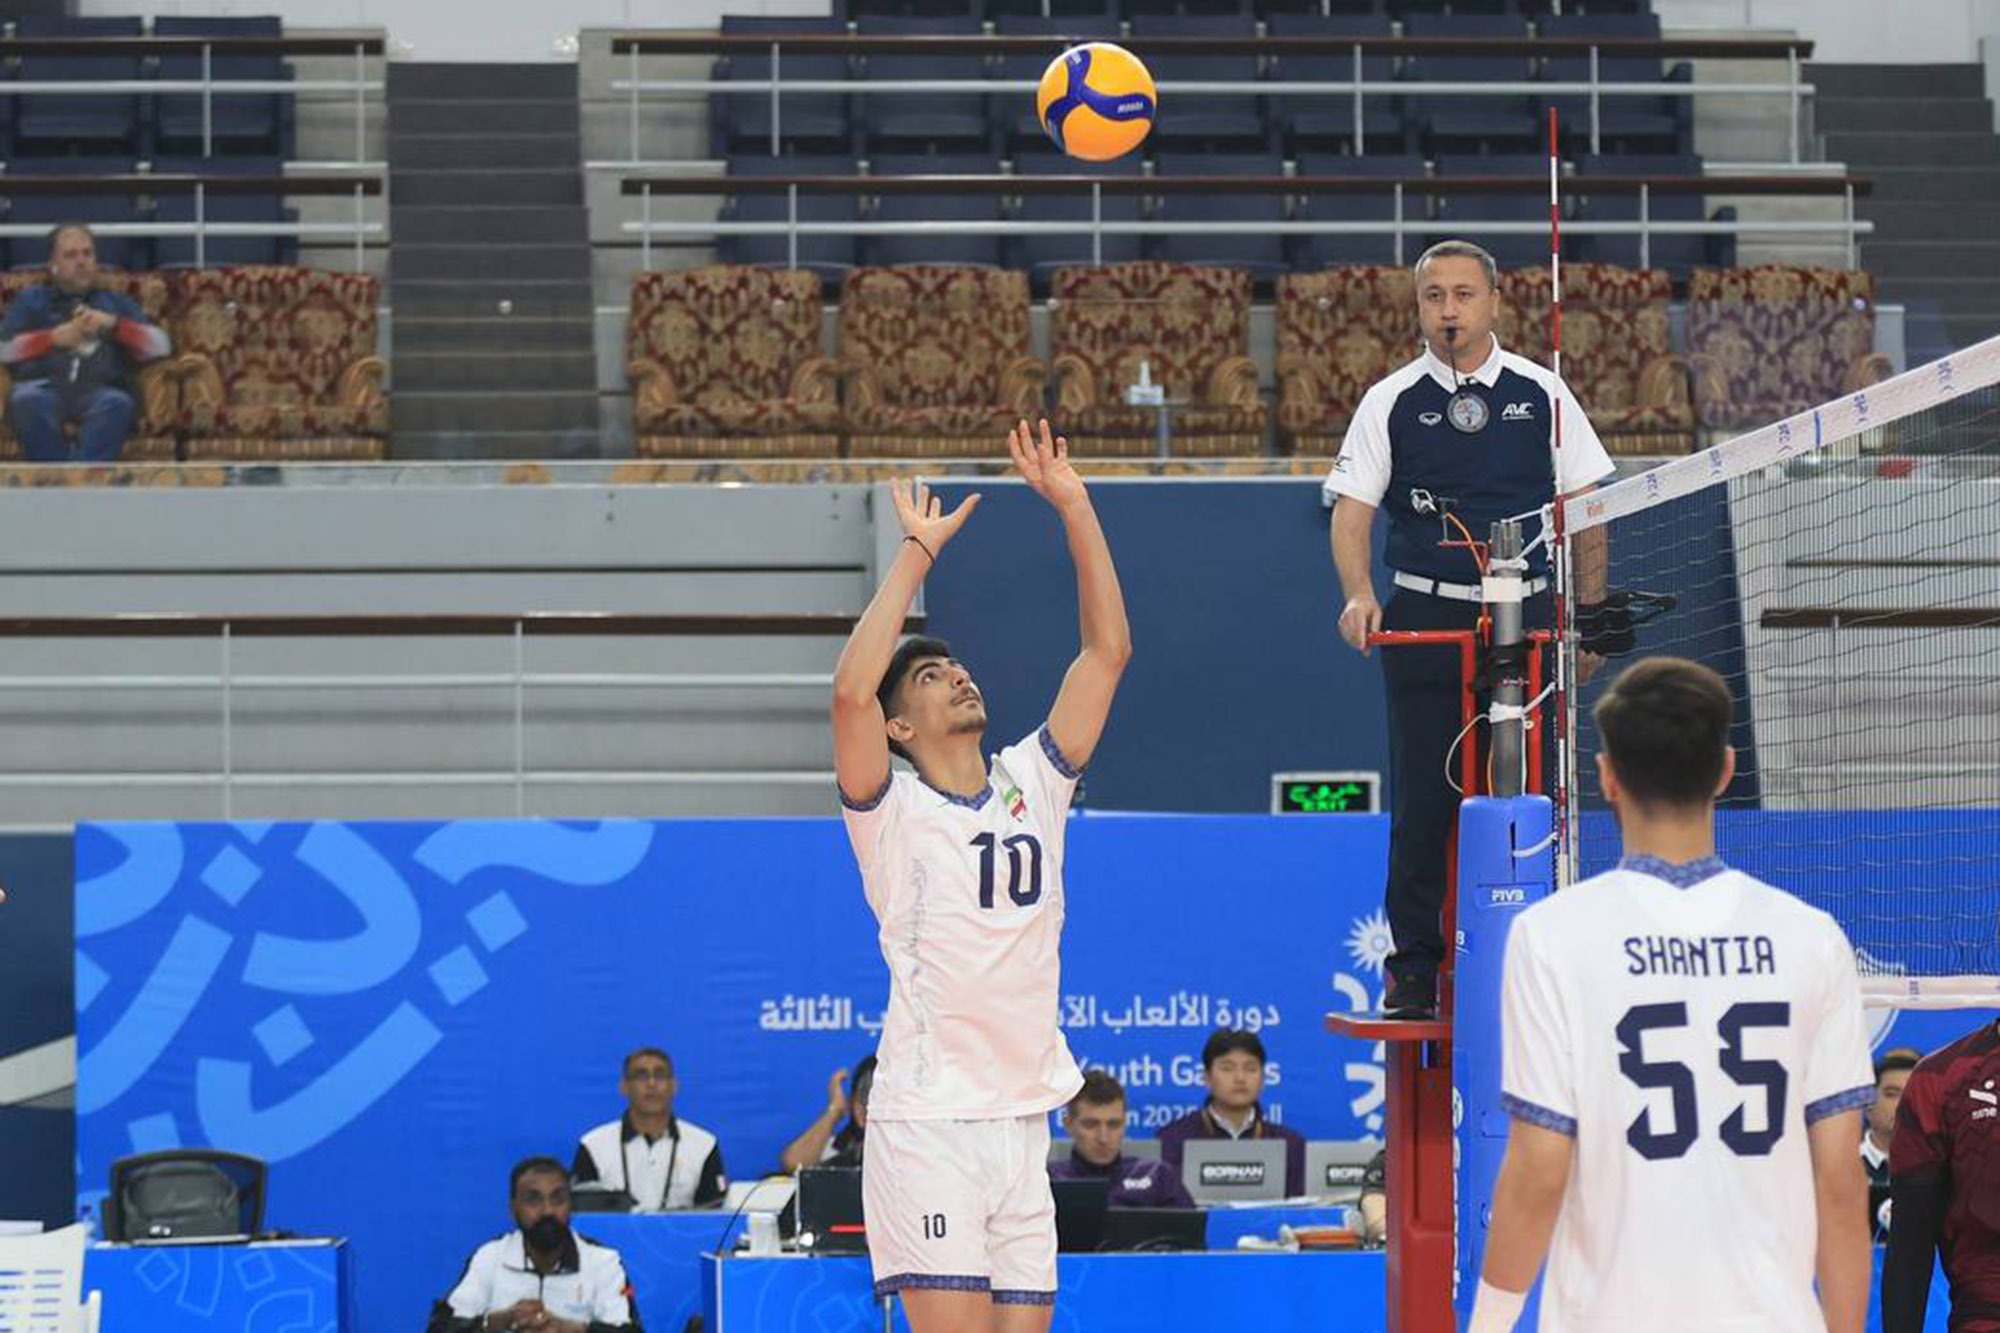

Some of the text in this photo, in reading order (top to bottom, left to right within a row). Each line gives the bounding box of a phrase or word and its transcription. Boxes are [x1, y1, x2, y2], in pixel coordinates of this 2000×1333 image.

[1502, 402, 1534, 417] AVC
[968, 831, 1042, 909] 10
[1491, 889, 1525, 902] FIVB
[1624, 935, 1775, 977] SHANTIA
[759, 994, 852, 1031] الثالثة
[1102, 990, 1208, 1034] الألعاب
[1215, 998, 1281, 1034] دورة
[1615, 1000, 1791, 1161] 55
[921, 1213, 946, 1240] 10
